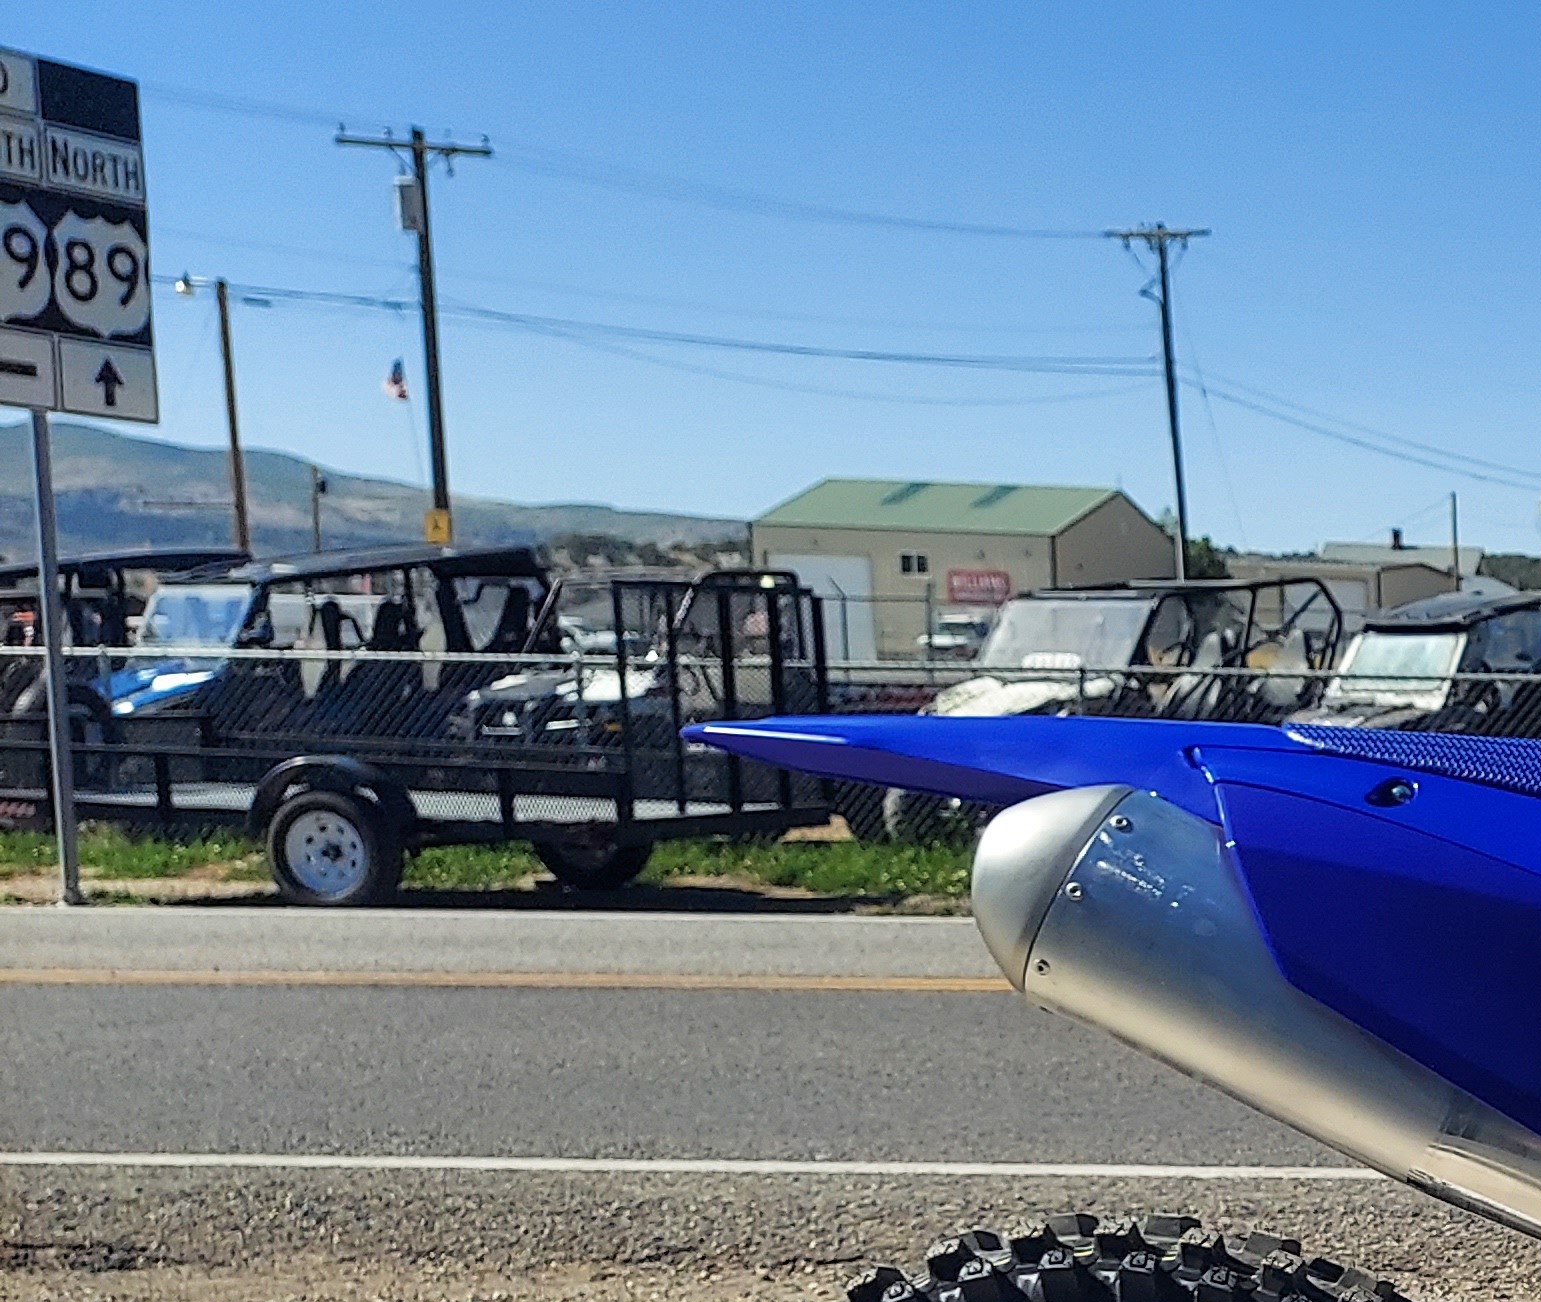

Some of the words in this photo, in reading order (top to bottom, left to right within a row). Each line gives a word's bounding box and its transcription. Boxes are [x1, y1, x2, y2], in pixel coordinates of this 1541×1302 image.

[51, 135, 139, 191] NORTH
[2, 226, 38, 290] 9
[66, 239, 139, 308] 89
